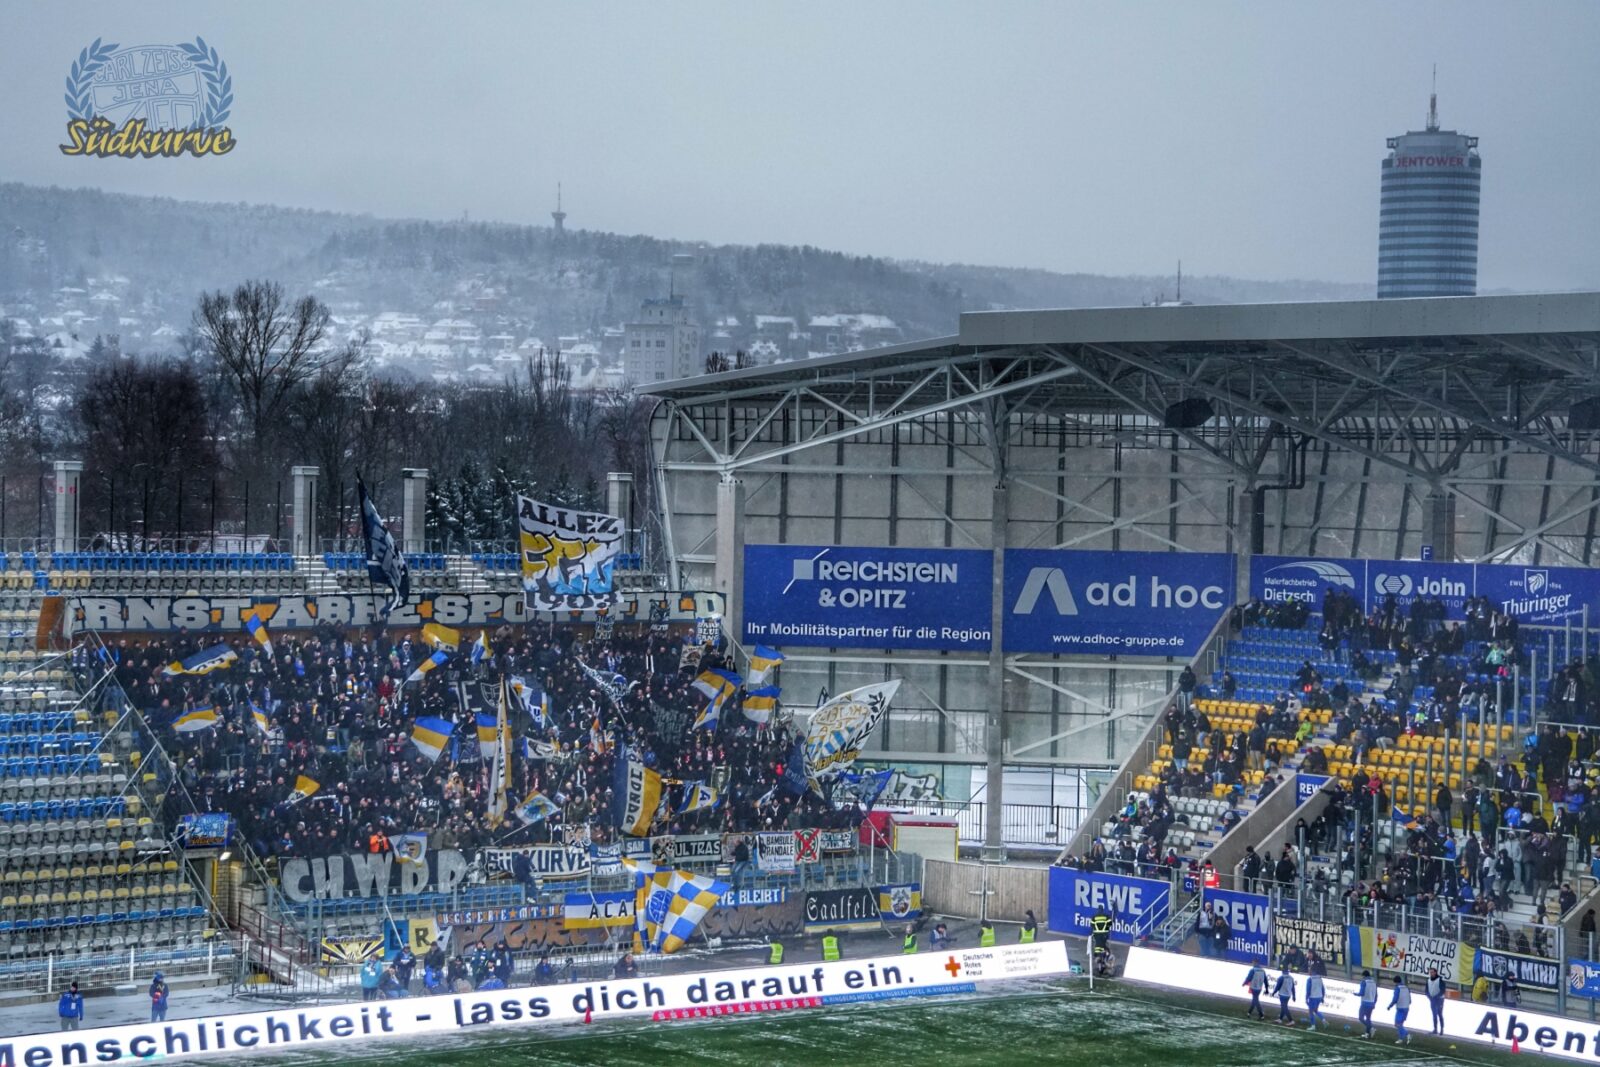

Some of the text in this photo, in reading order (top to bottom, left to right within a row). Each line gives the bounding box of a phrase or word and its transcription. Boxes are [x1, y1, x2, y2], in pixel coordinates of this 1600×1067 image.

[1395, 156, 1465, 168] JENTOWER
[520, 499, 619, 534] ALLEZ
[1422, 546, 1431, 559] F
[1086, 576, 1224, 609] ad hoc
[1264, 577, 1318, 587] Malerfachbetrieb
[1417, 576, 1466, 596] John
[818, 589, 907, 609] & OPITZ
[1501, 594, 1572, 617] Thüringer
[747, 622, 991, 643] Ihr Mobilitätspartner für die Region
[1053, 632, 1185, 648] www.adhoc-gruppe.de
[674, 840, 722, 856] ULTRAS
[487, 848, 591, 874] SÜKURVE
[1074, 879, 1143, 916] REWE
[588, 899, 637, 920] ACA
[1214, 899, 1269, 934] REW
[1275, 925, 1343, 953] WOLFPACK
[1408, 935, 1456, 959] FANCLUB
[573, 979, 666, 1015] dich
[687, 967, 825, 1004] darauf
[843, 962, 916, 990] ein.
